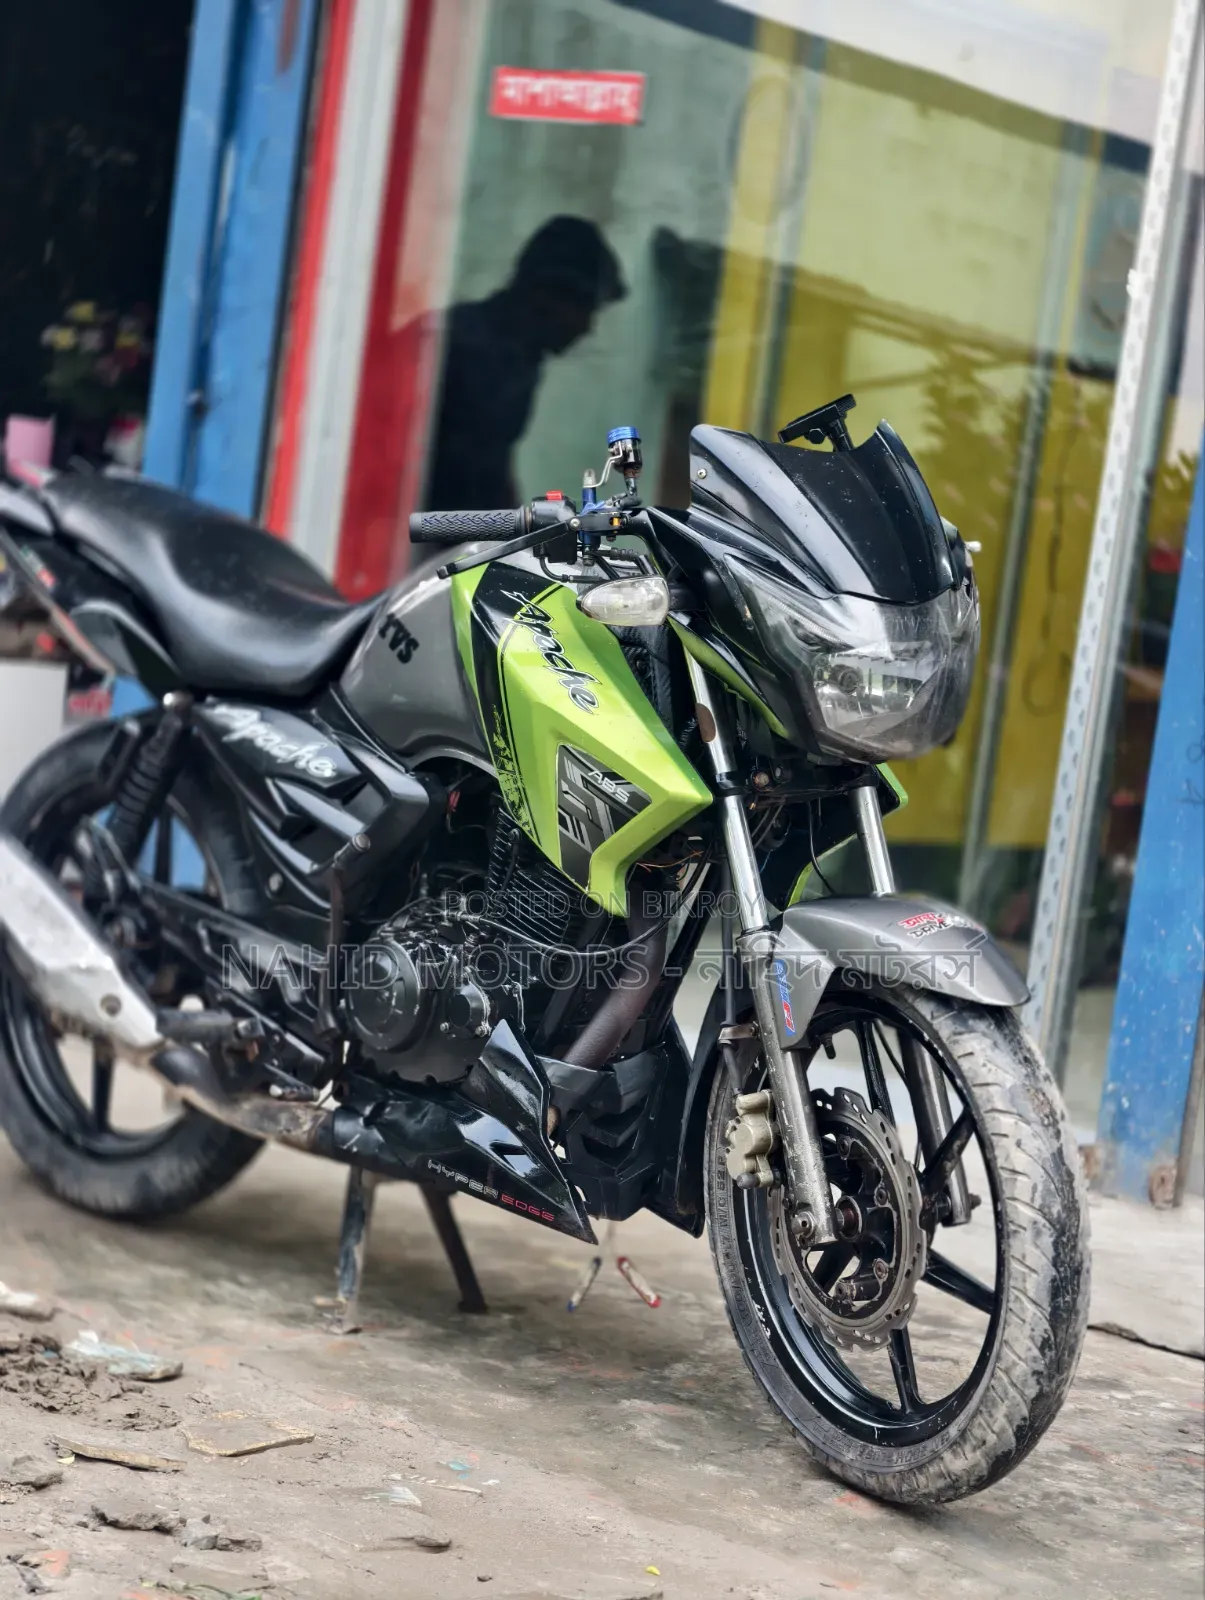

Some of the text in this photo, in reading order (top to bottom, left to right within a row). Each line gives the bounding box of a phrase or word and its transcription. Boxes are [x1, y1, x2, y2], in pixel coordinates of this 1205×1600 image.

[379, 613, 420, 664] TVS
[500, 589, 603, 715] Apache
[213, 704, 337, 778] Apache
[588, 769, 631, 804] ABS
[909, 921, 951, 937] DRIVE
[427, 1159, 555, 1222] HYPER EDGE
